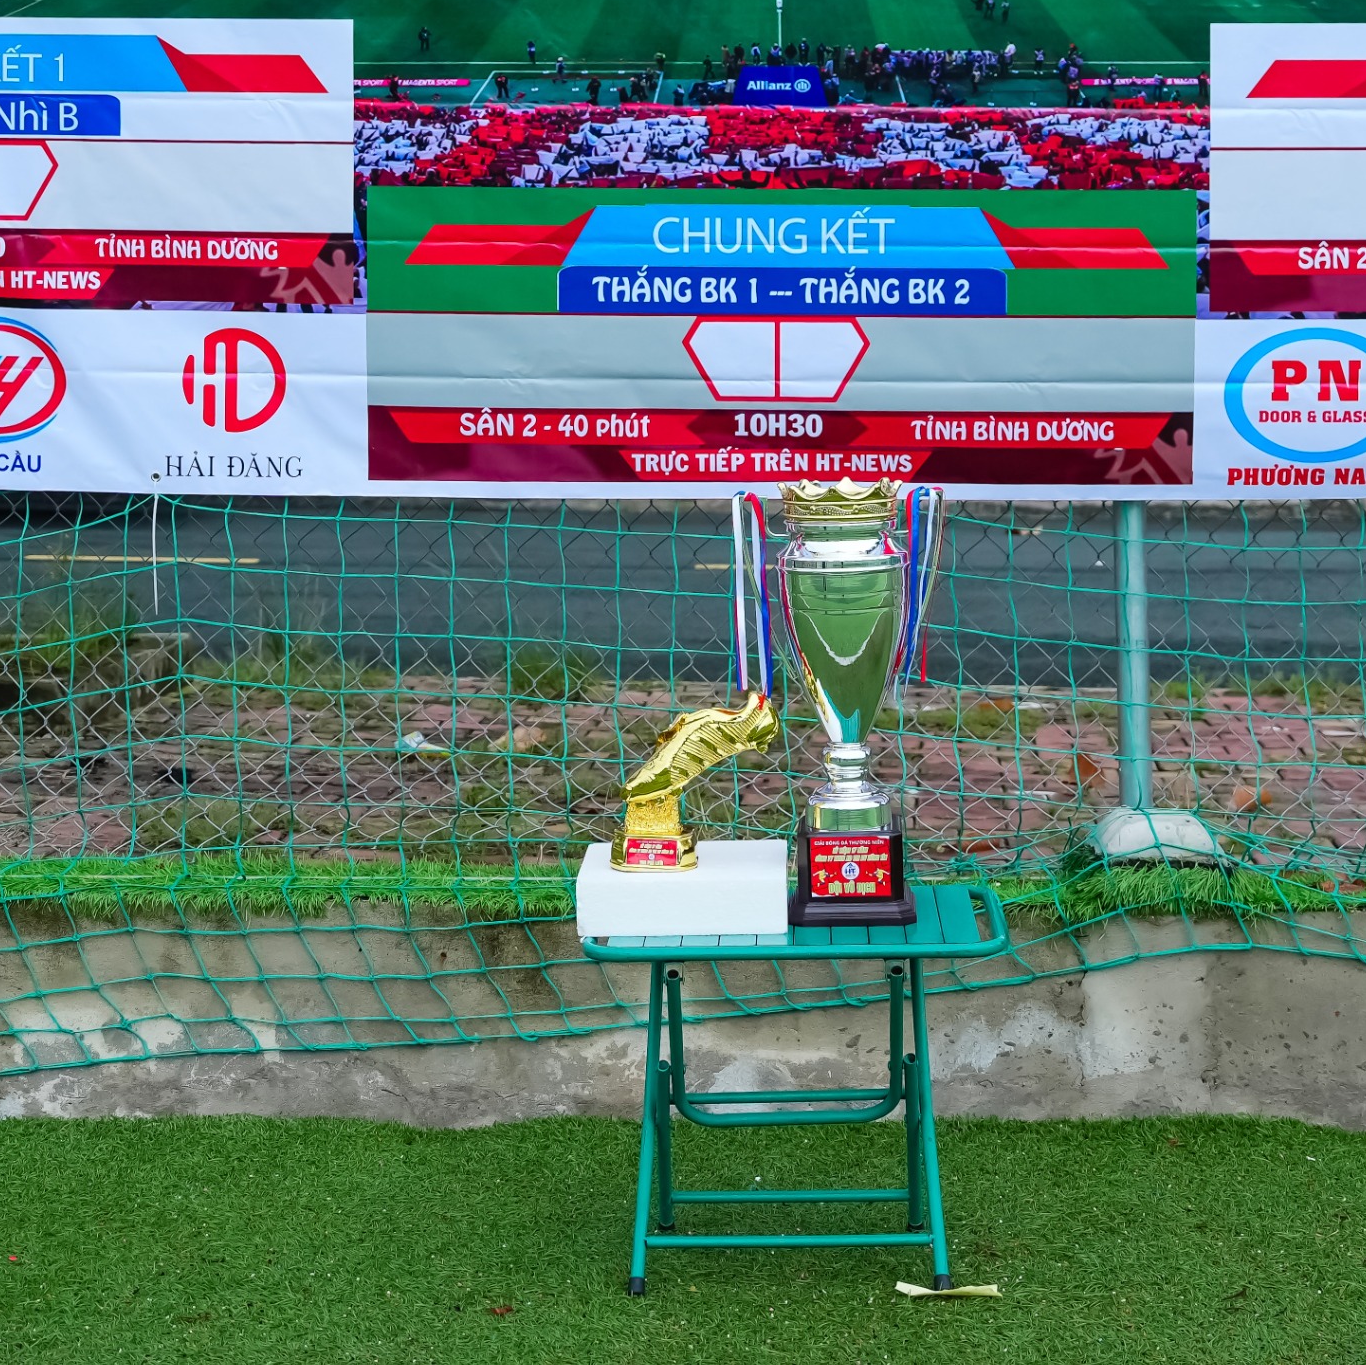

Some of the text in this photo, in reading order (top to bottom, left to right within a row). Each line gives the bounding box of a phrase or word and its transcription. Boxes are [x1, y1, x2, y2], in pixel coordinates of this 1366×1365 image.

[53, 55, 65, 81] 1
[747, 81, 791, 90] Allianz
[59, 105, 79, 131] B
[653, 207, 895, 254] CHUNG KẾT
[10, 269, 101, 290] HT-NEWS
[1259, 410, 1302, 423] DOOR
[1307, 410, 1317, 423] &
[165, 447, 303, 479] HẢI ĐĂNG
[1227, 464, 1325, 486] PHƯƠNG
